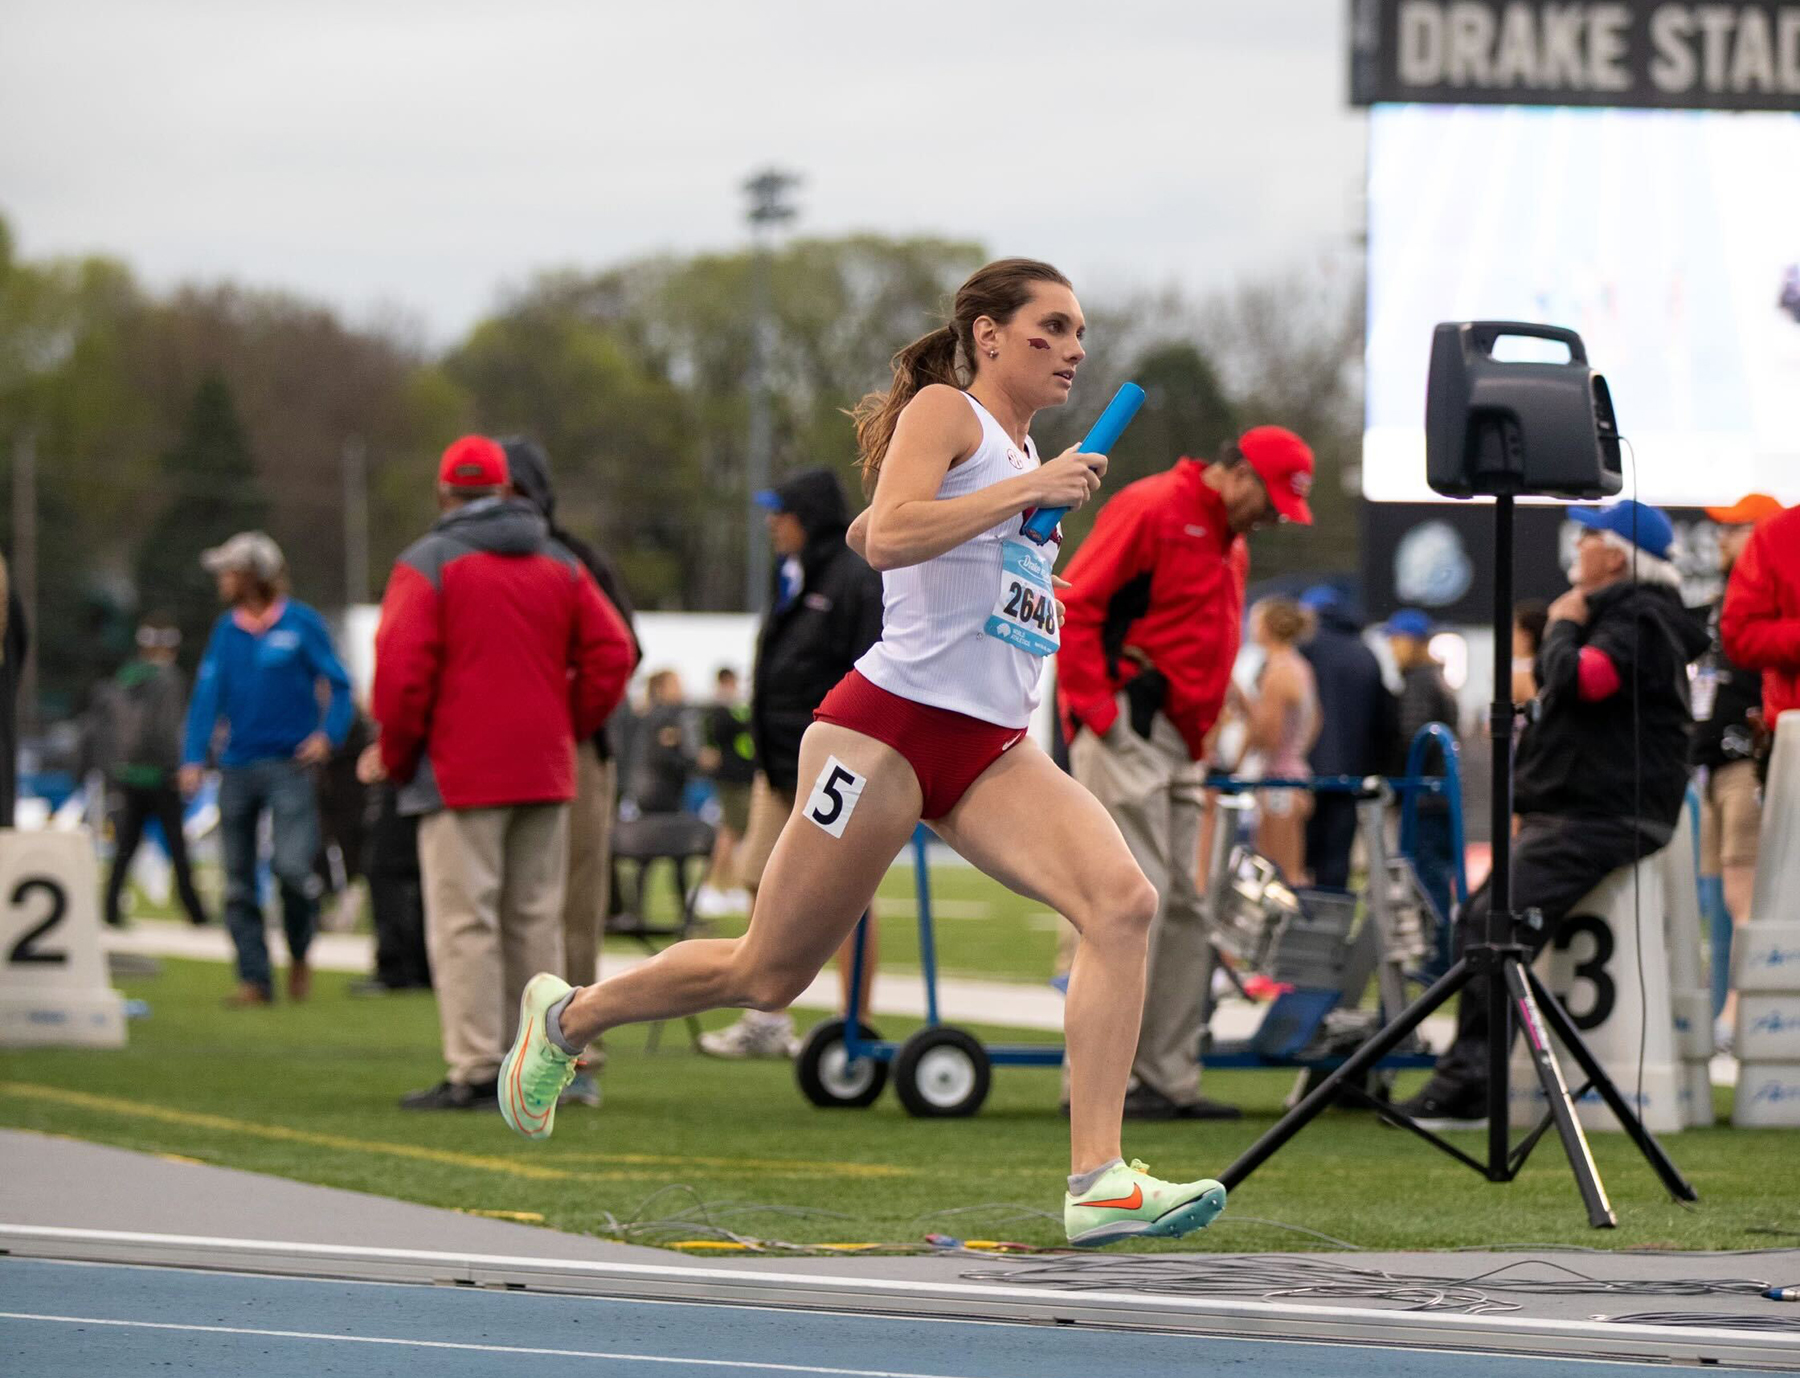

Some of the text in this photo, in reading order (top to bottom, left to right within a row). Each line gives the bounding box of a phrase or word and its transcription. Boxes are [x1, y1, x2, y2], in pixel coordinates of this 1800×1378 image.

[1401, 3, 1634, 91] DRAKE
[1003, 581, 1055, 635] 2648
[812, 765, 855, 825] 5
[9, 876, 68, 963] 2
[1553, 914, 1616, 1030] 3
